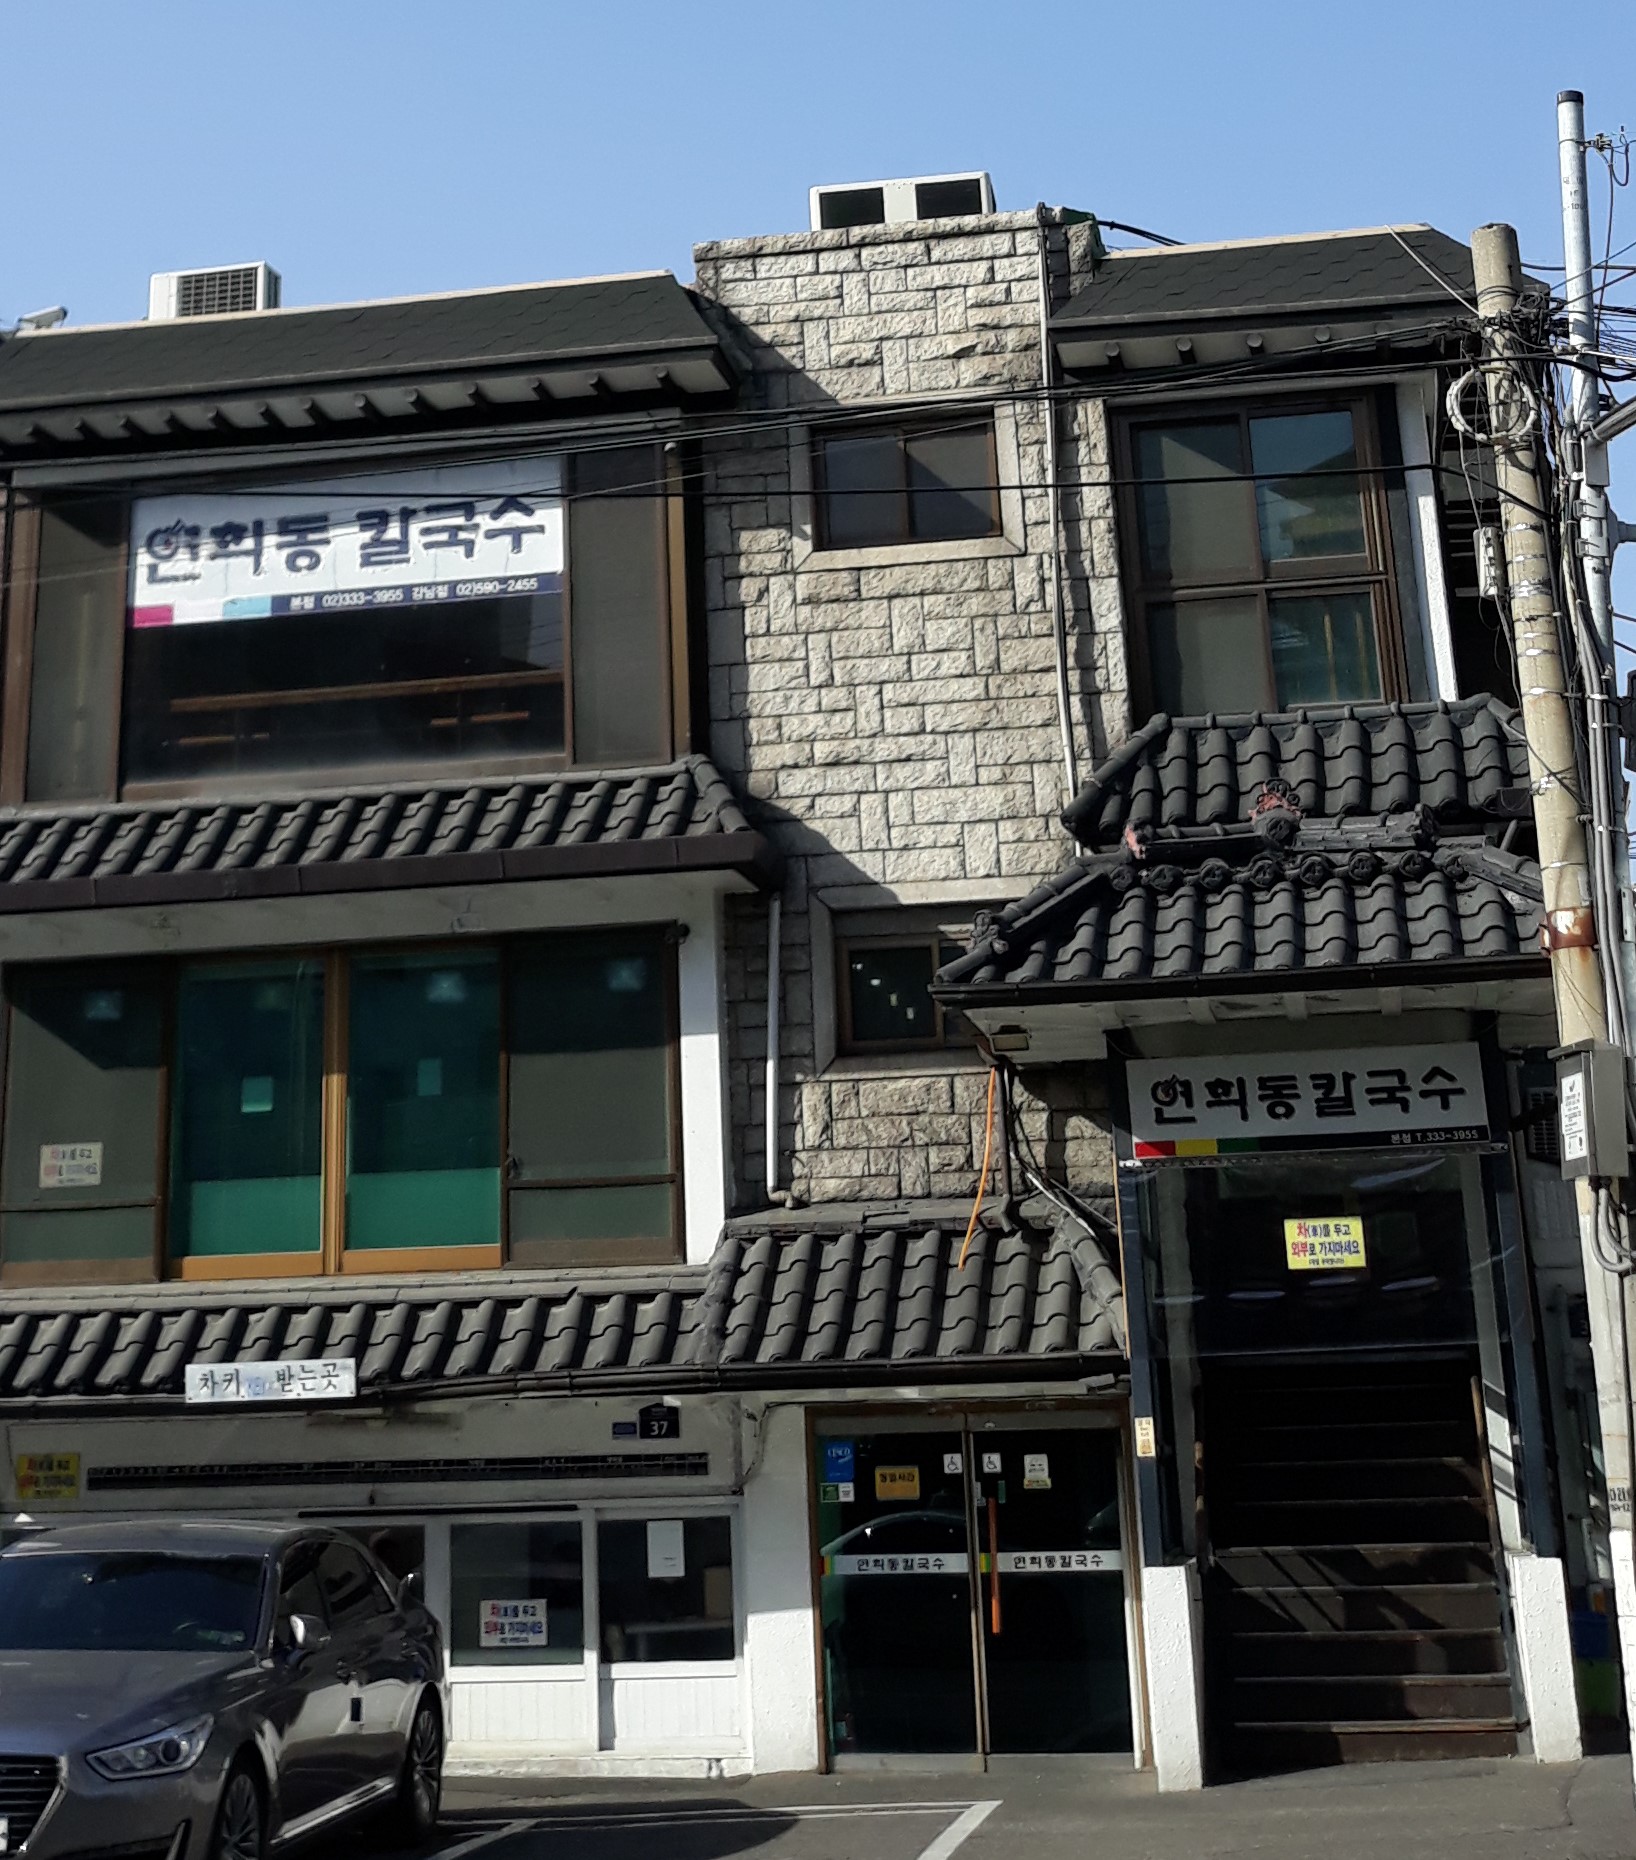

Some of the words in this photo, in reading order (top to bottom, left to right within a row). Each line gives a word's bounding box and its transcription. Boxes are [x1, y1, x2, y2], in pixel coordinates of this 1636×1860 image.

[355, 496, 547, 569] 칼국수
[321, 588, 404, 608] 02)333-3955
[411, 583, 449, 601] 강남점
[1150, 1065, 1467, 1126] 연희동칼국수
[1333, 1223, 1352, 1236] 두고
[1291, 1240, 1317, 1257] 외부로
[1319, 1239, 1361, 1257] 가지마세요
[199, 1367, 241, 1397] 차키
[649, 1421, 669, 1436] 37
